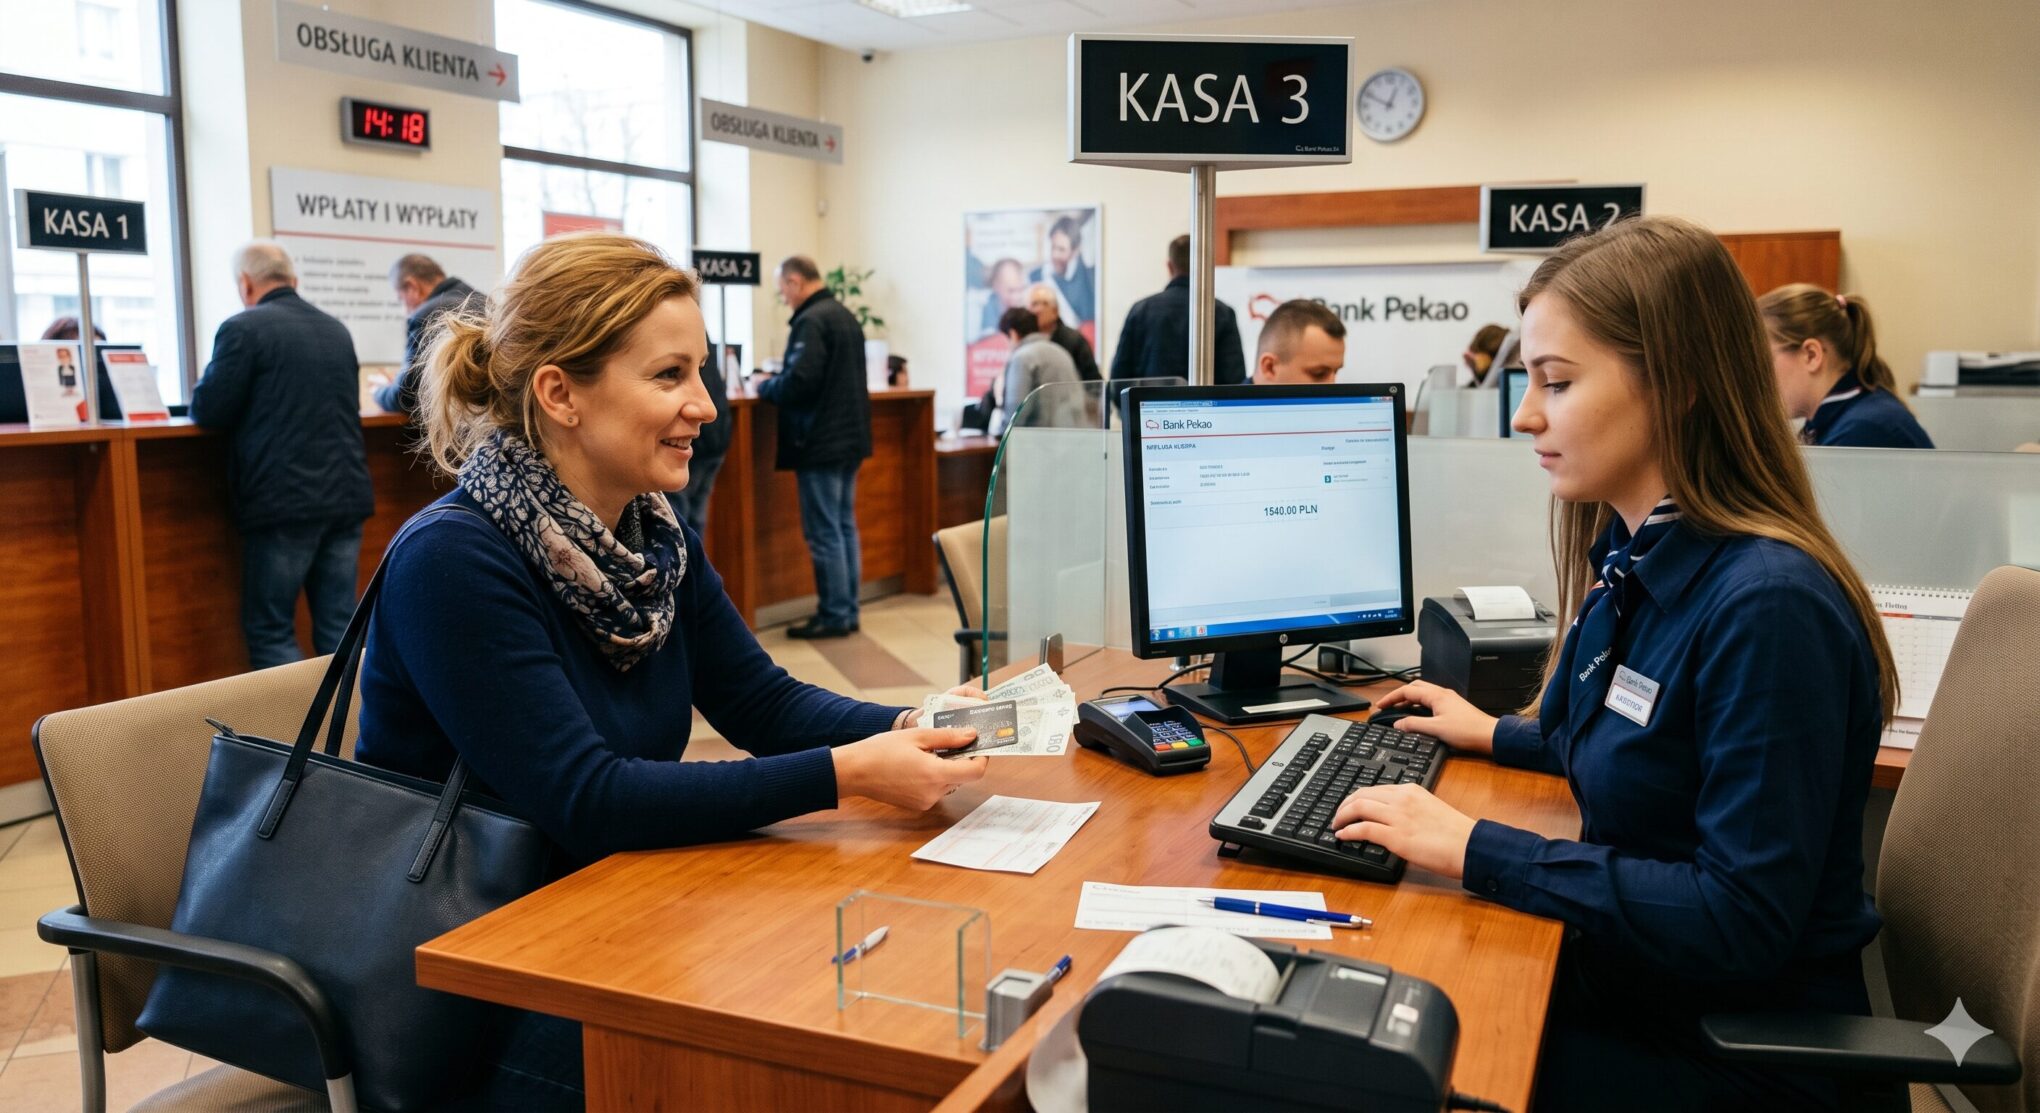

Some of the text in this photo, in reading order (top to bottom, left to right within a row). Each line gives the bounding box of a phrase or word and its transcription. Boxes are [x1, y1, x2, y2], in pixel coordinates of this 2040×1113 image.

[297, 22, 480, 81] OBSŁUGA KLIENTA
[1119, 72, 1310, 125] KASA 3
[364, 107, 425, 144] 14:18
[772, 124, 820, 149] KLIENTA
[44, 207, 129, 240] KASA 1
[296, 193, 478, 230] WPŁATY I WYPŁATY
[1509, 202, 1590, 233] KASA
[699, 257, 753, 278] KASA 2
[1384, 296, 1470, 322] Pekao
[1162, 419, 1213, 430] Bank Pekao
[1263, 504, 1318, 516] 1540.00 PLN
[1578, 662, 1597, 682] Bank
